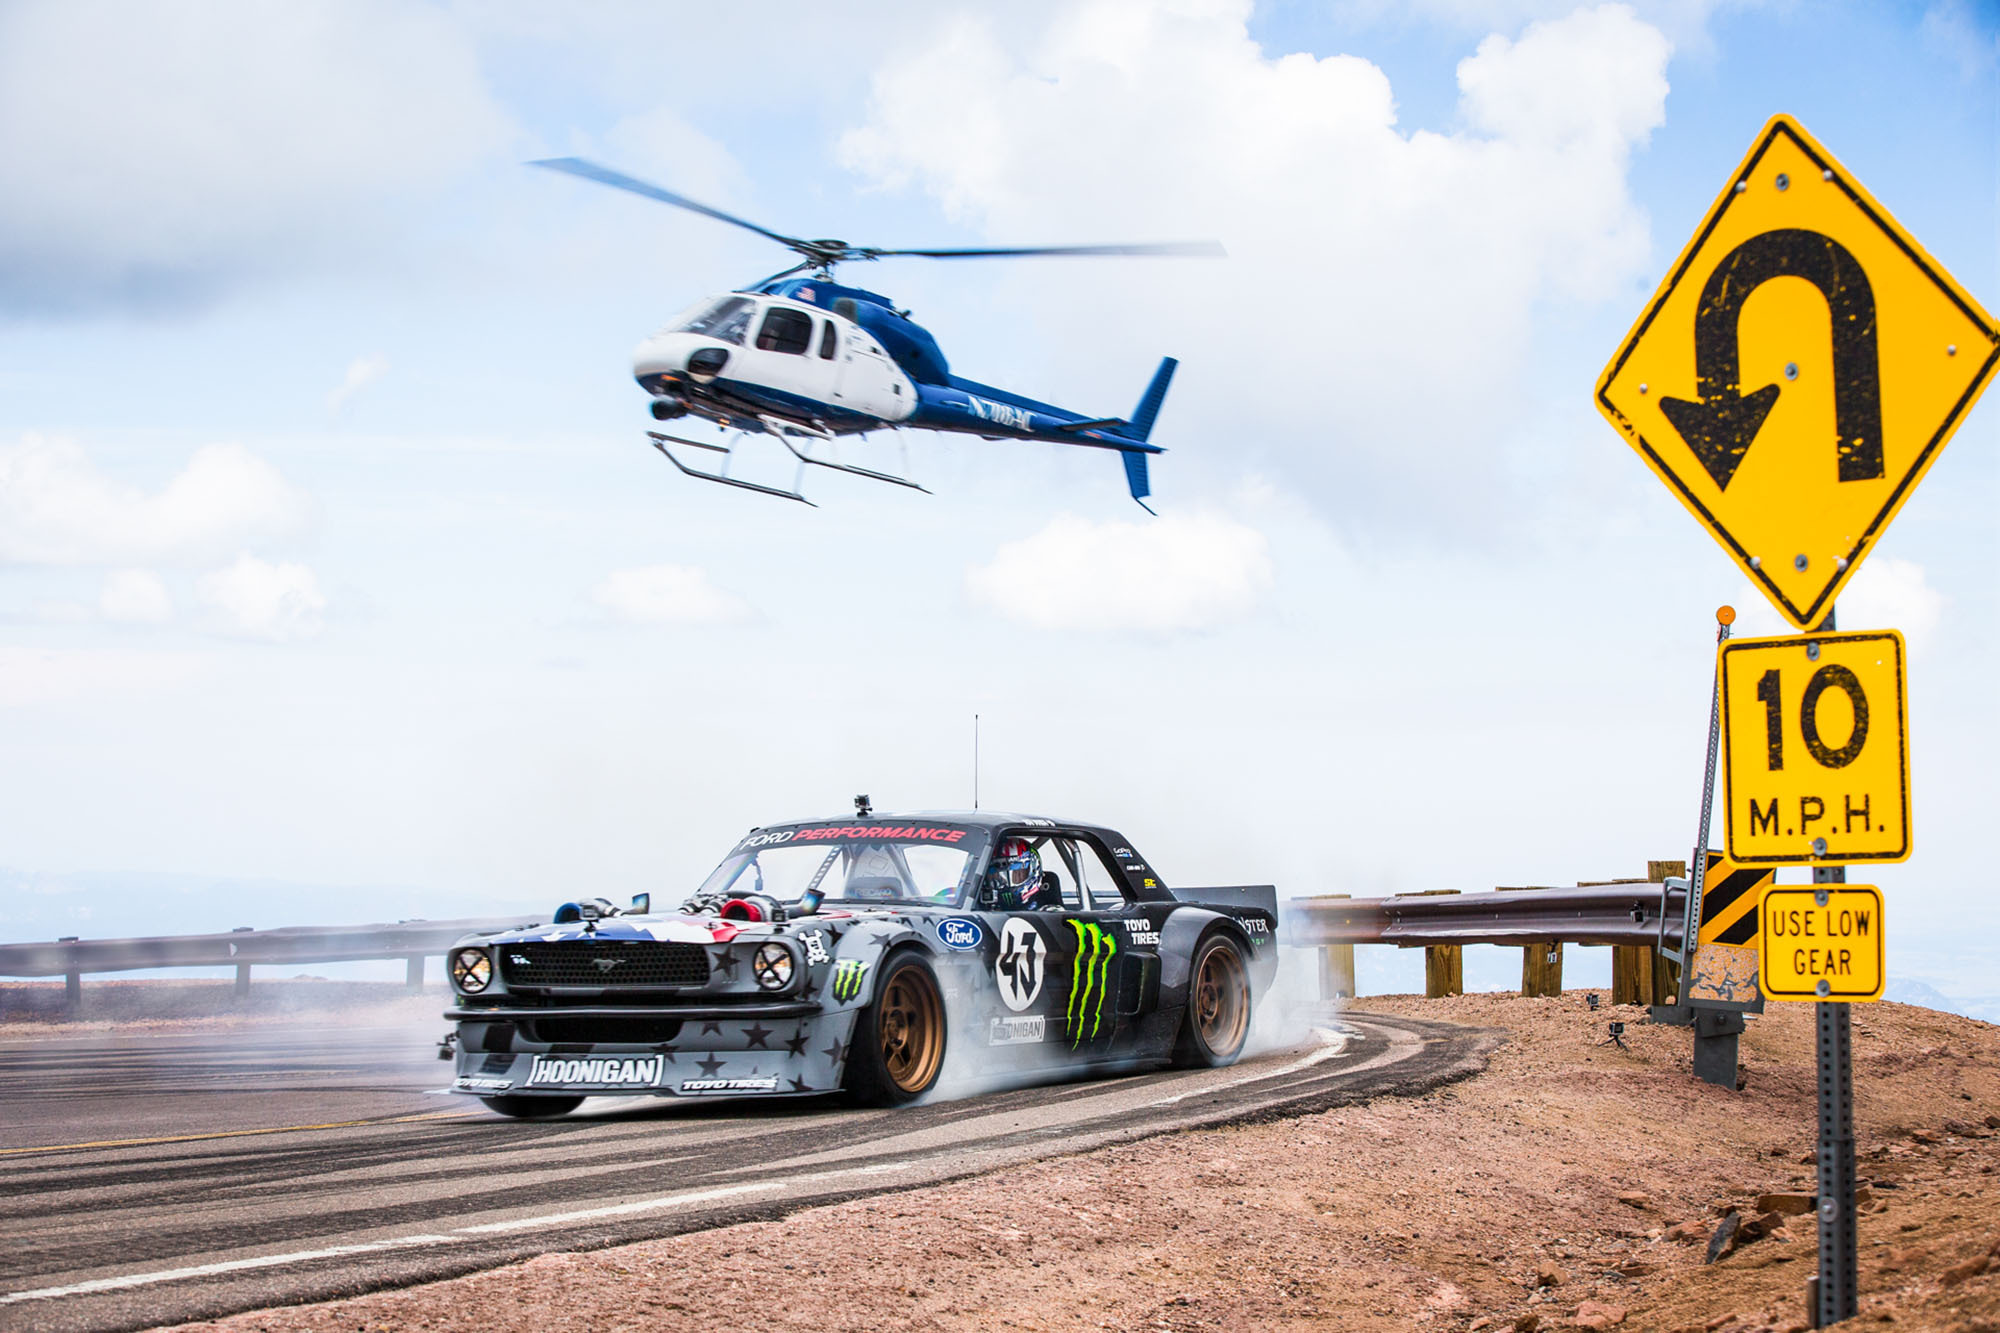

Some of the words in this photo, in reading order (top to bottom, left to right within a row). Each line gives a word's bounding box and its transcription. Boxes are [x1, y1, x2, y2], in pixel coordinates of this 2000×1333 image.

[1757, 664, 1870, 771] 10
[1749, 793, 1885, 836] M.P.H.
[742, 830, 795, 850] FORD
[791, 826, 967, 843] PERFORMANCE
[945, 921, 974, 944] Ford
[1123, 918, 1151, 932] TOYO
[1773, 910, 1815, 936] USE
[1826, 910, 1870, 936] LOW
[1131, 931, 1161, 945] TIRES
[1793, 948, 1852, 975] GEAR
[682, 1079, 726, 1091] TOYO
